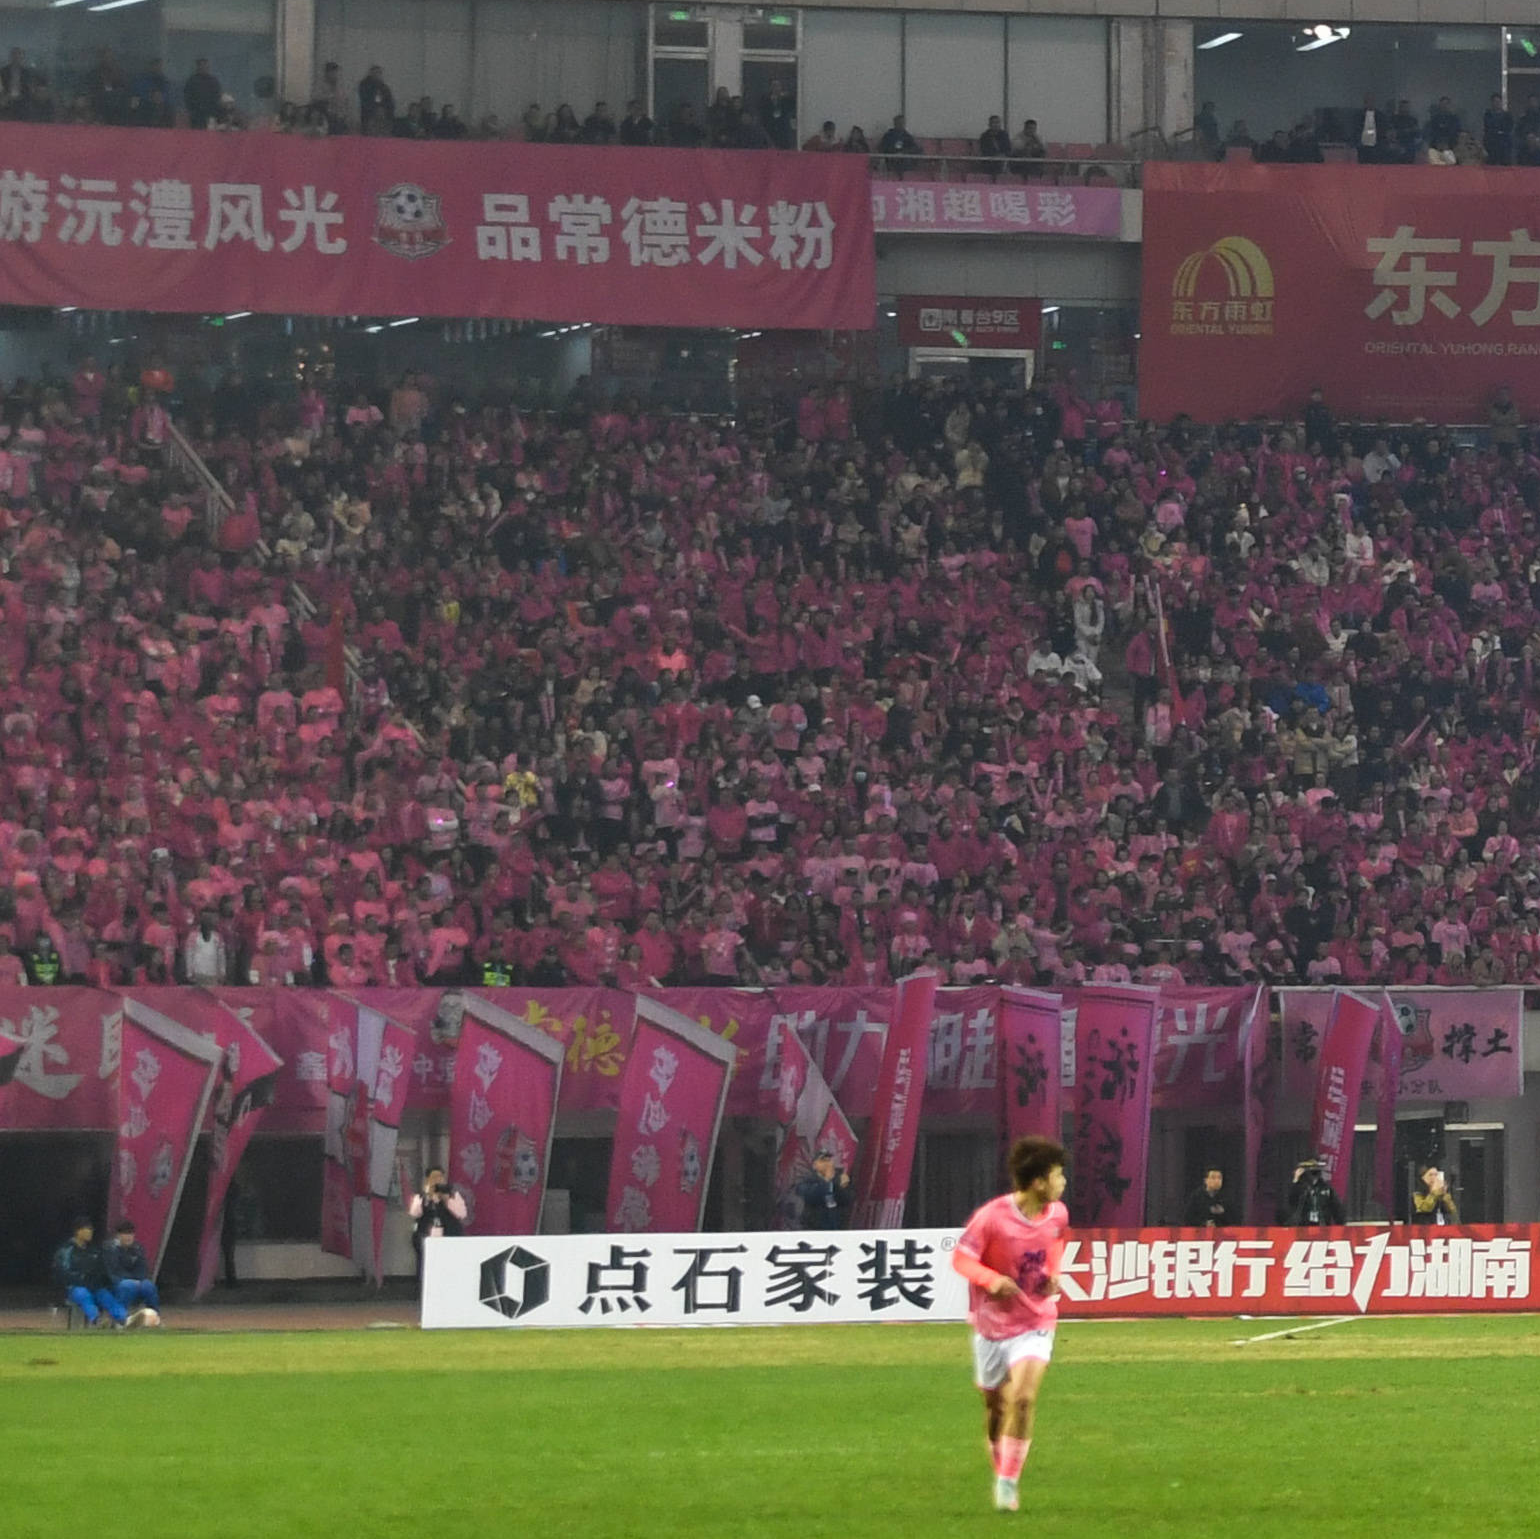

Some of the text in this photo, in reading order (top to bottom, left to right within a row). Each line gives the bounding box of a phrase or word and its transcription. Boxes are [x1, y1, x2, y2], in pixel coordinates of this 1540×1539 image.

[476, 193, 836, 272] 品常德米粉
[578, 1239, 935, 1314] 点石家装
[1284, 1231, 1532, 1313] 给力湖南
